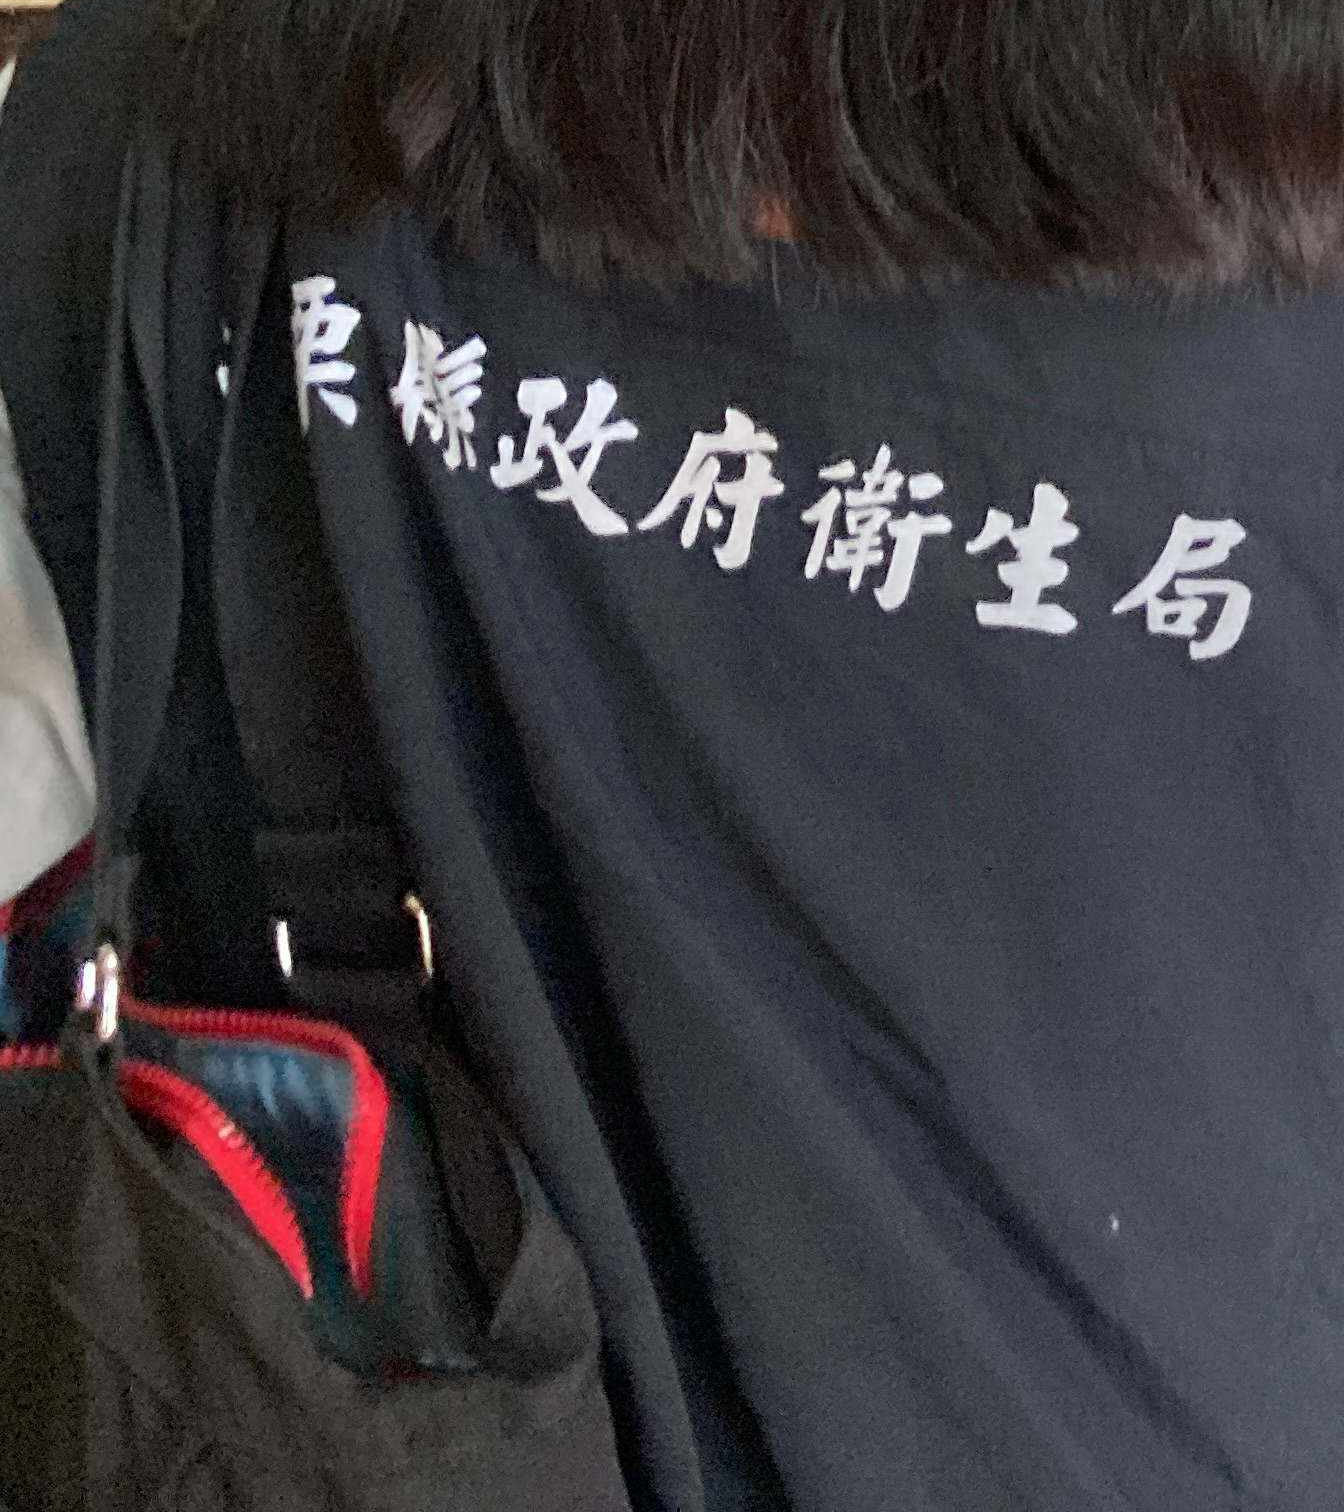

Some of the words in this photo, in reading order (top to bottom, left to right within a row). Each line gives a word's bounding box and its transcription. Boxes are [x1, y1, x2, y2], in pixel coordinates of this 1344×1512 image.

[216, 273, 1253, 660] 栗縣政府衛生局
